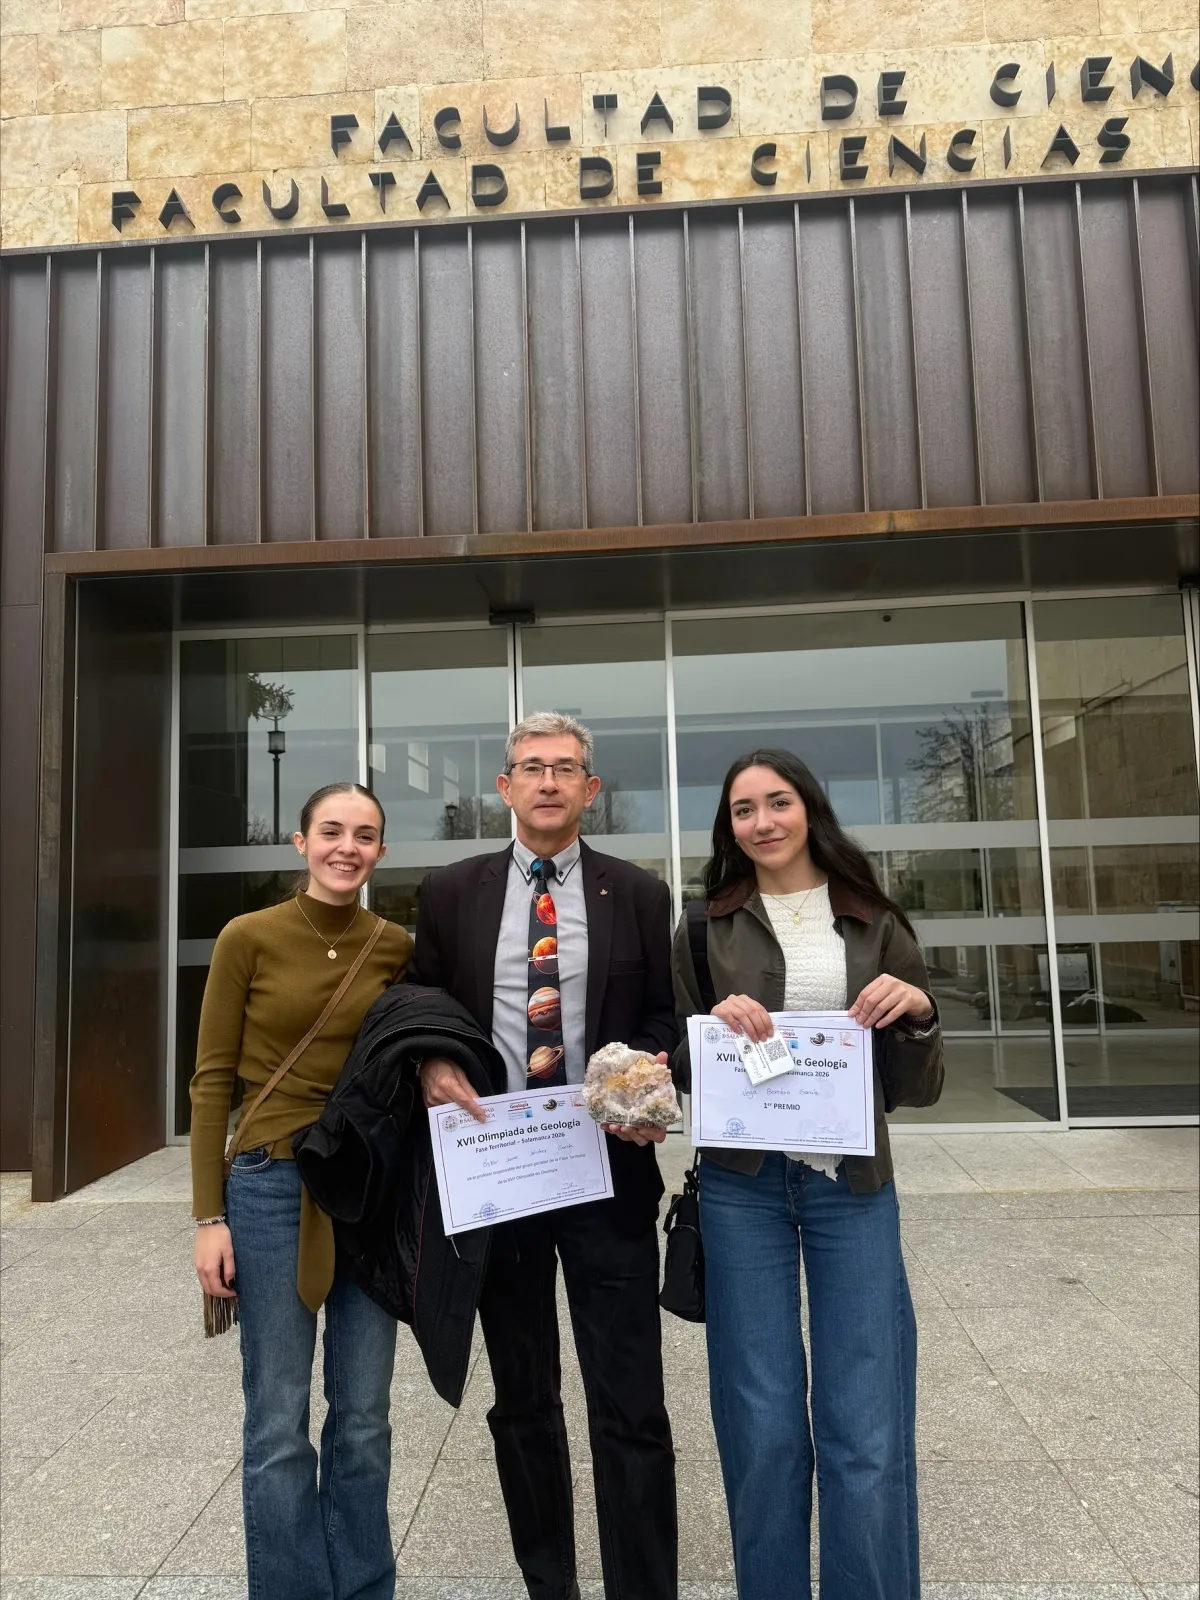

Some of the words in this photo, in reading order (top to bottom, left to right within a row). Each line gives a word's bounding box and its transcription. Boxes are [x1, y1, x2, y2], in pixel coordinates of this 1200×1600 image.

[330, 86, 733, 158] FACULTAD
[820, 70, 908, 121] DE
[989, 52, 1200, 108] CIEN
[111, 163, 509, 234] FACULTAD
[579, 150, 663, 200] DE
[751, 117, 1131, 189] CIENCIAS
[716, 1052, 736, 1063] XVII
[804, 1057, 848, 1070] Geología
[773, 1103, 801, 1111] PREMIO
[456, 1135, 476, 1148] XVII
[477, 1125, 525, 1143] Olimpiada
[527, 1124, 539, 1134] de
[540, 1118, 581, 1132] Geología
[489, 1139, 516, 1151] Territorial
[521, 1133, 551, 1144] Salamanca
[551, 1131, 566, 1140] 2026
